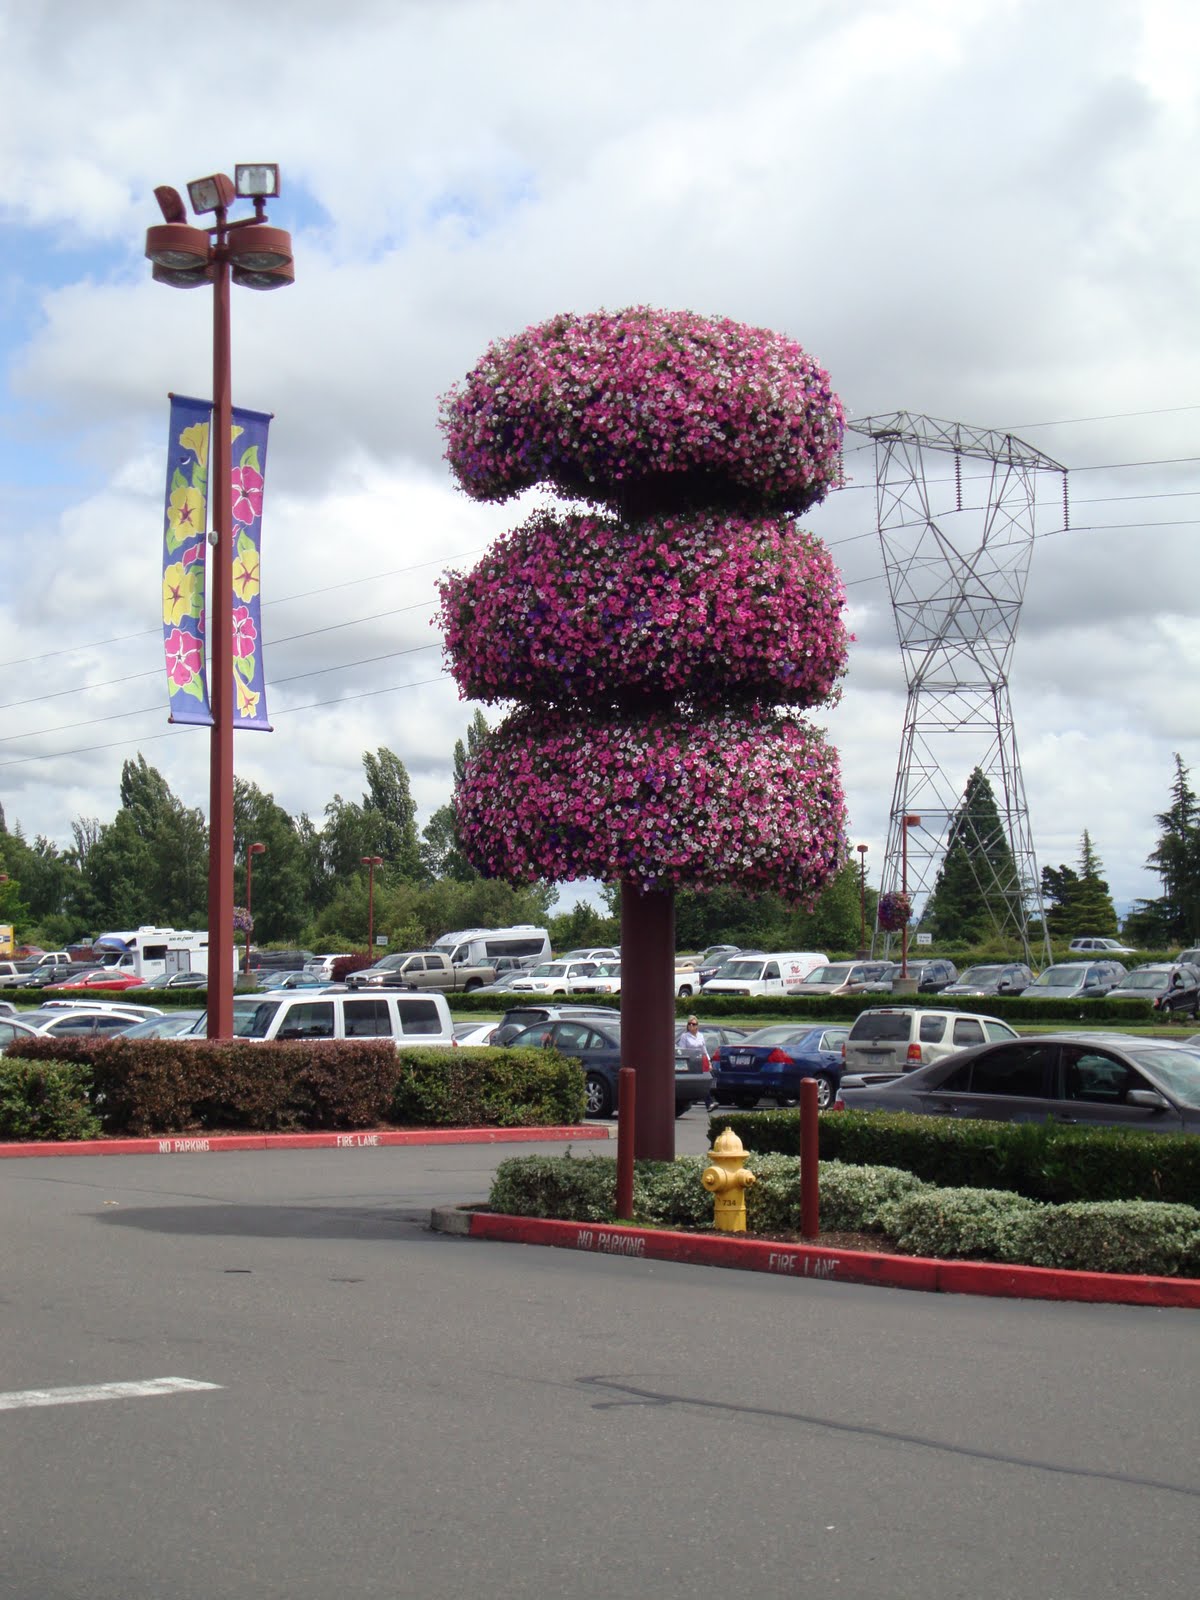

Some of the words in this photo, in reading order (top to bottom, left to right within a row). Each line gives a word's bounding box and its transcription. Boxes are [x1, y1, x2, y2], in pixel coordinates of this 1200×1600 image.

[159, 1140, 171, 1154] NO
[174, 1139, 210, 1153] PARKING
[336, 1135, 355, 1147] FIRE
[357, 1134, 379, 1147] LANE
[577, 1230, 593, 1249] NO
[597, 1232, 646, 1256] PARKING
